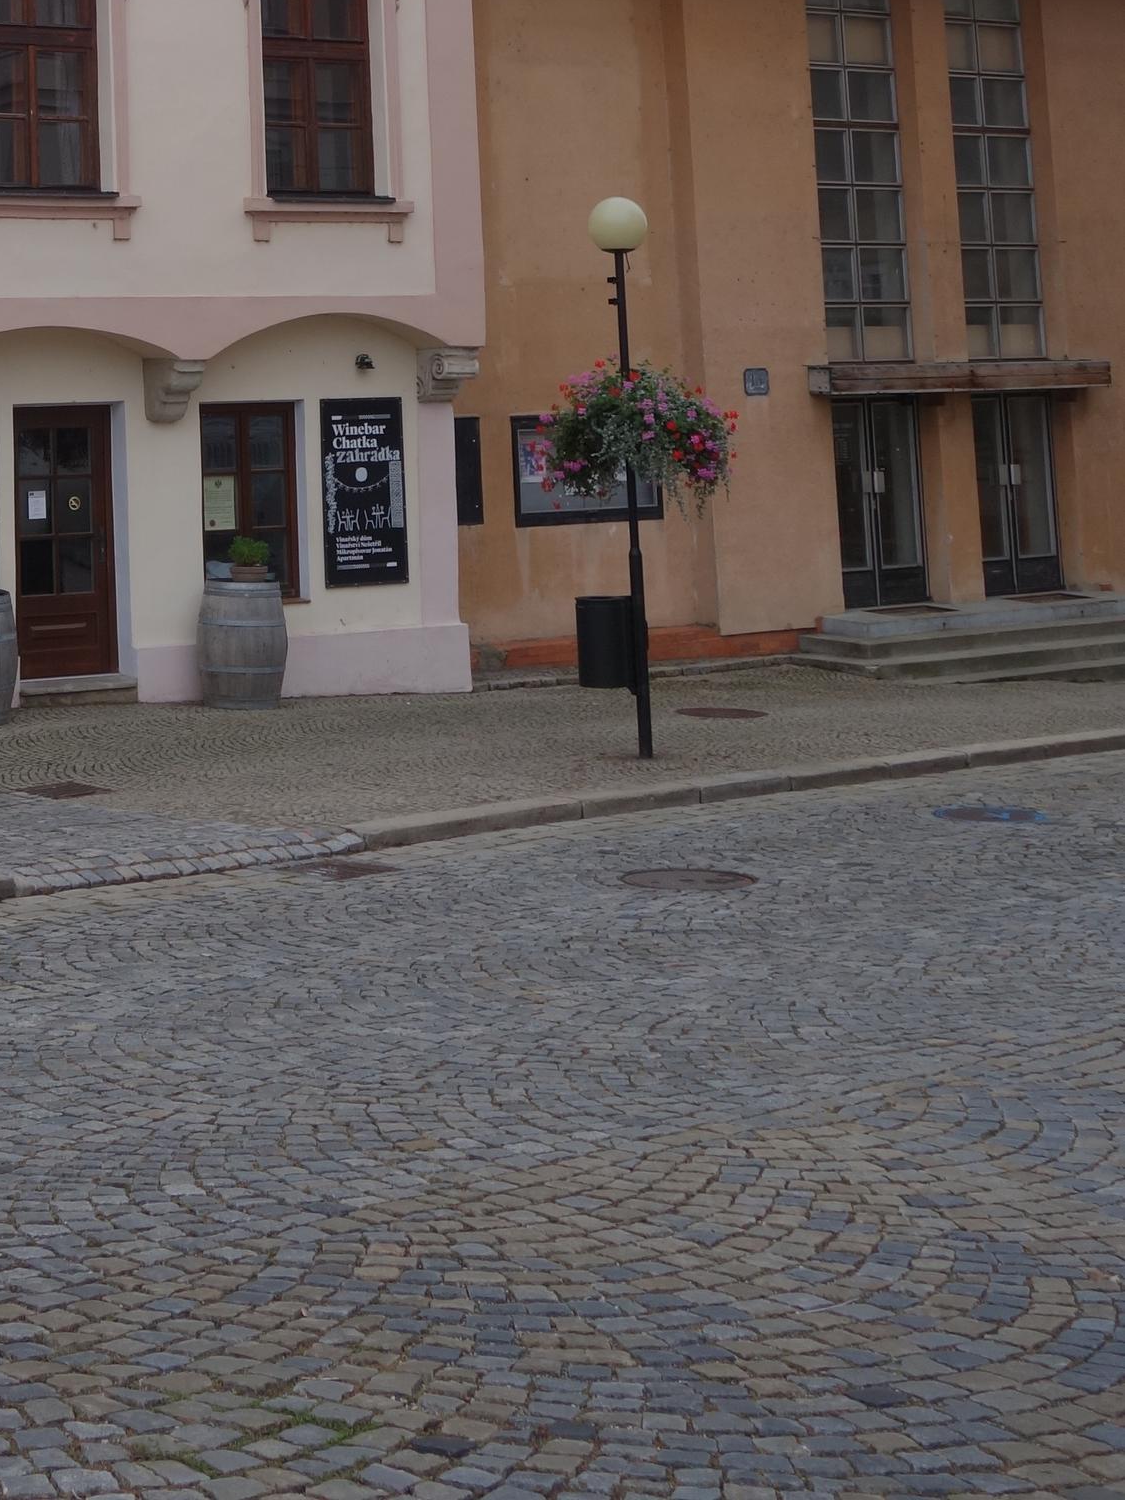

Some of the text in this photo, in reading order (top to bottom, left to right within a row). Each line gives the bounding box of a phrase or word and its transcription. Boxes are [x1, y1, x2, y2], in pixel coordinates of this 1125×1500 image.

[331, 422, 386, 436] Winebar
[332, 436, 378, 449] Chatka
[336, 445, 400, 463] zahrádka
